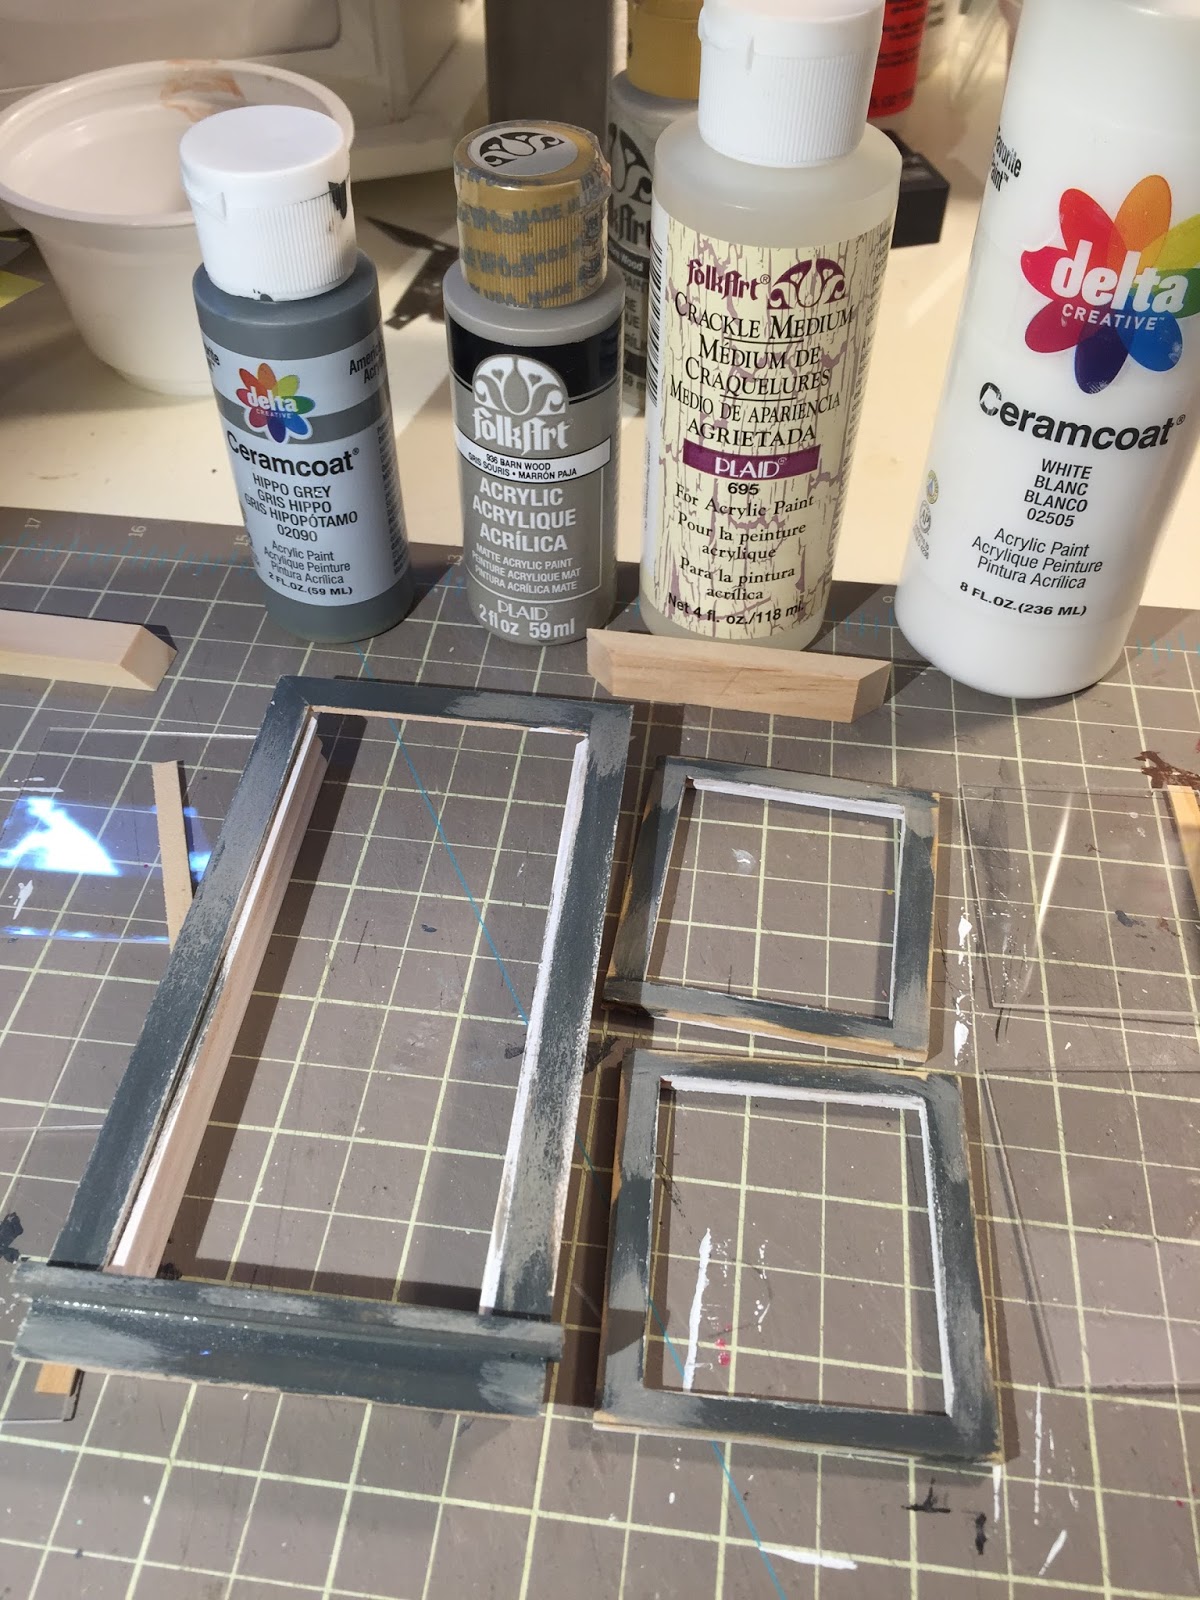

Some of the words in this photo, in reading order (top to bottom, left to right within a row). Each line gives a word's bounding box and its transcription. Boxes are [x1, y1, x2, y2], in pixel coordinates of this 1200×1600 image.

[1051, 239, 1188, 313] delta
[675, 291, 760, 339] CRACKLE
[769, 304, 854, 340] MEDIUM
[1062, 303, 1158, 331] CREATIVE
[698, 333, 786, 370] MÉDIUM
[794, 346, 821, 366] DE
[685, 356, 831, 397] CRAQUELURES
[247, 386, 298, 412] delta
[670, 374, 714, 415] MEDIO
[719, 401, 741, 423] DE
[747, 391, 841, 424] APARIENCIA
[256, 408, 292, 419] CREATIVE
[687, 418, 816, 448] AGRIETADA
[483, 460, 510, 477] SOURIS
[518, 470, 555, 480] MARRÓN
[558, 468, 577, 478] PAJA
[486, 453, 498, 465] 936
[500, 458, 522, 470] BARN
[524, 462, 551, 471] WOOD
[714, 456, 780, 478] PLAID
[1041, 458, 1093, 480] WHITE
[252, 472, 289, 496] HIPPO
[293, 485, 331, 499] GREY
[479, 477, 563, 507] ACRYLIC
[727, 482, 759, 496] 695
[1034, 475, 1089, 496] BLANC
[244, 492, 268, 515] GRIS
[269, 506, 358, 528] HIPOPÓTAMO
[257, 488, 285, 509] GRIS
[288, 499, 332, 514] HIPPO
[472, 495, 576, 530] ACRYLIQUE
[675, 482, 699, 507] For
[704, 498, 767, 520] Acrylic
[774, 495, 815, 515] Paint
[1024, 489, 1089, 513] BLANCO
[677, 510, 713, 537] Pour
[719, 526, 734, 542] la
[740, 523, 807, 545] peinture
[1026, 507, 1075, 527] 02505
[276, 523, 318, 542] 02090
[480, 522, 568, 553] ACRÍLICA
[994, 528, 1047, 554] Acrylic
[1050, 541, 1090, 558] Paint
[264, 546, 304, 570] Acrylique
[307, 562, 351, 573] Peinture
[272, 540, 304, 559] Acrylic
[307, 550, 334, 561] Paint
[476, 543, 501, 563] MATTE
[503, 556, 542, 571] ACRYLIC
[545, 557, 573, 570] PAINT
[701, 544, 776, 563] acrylique
[971, 536, 1039, 570] Acrylique
[1042, 557, 1103, 574] Peinture
[268, 571, 274, 580] 2
[271, 560, 302, 581] Pintura
[472, 550, 506, 577] PEINTURE
[507, 570, 561, 584] ACRYLIQUE
[562, 567, 581, 581] MAT
[475, 565, 506, 589] PINTURA
[508, 583, 550, 595] ACRÍLICA
[551, 580, 578, 594] MATE
[680, 556, 713, 580] Para
[718, 572, 733, 583] la
[738, 568, 796, 587] pintura
[977, 555, 1027, 584] Pintura
[1030, 572, 1087, 590] Acrílica
[706, 587, 764, 600] acrílica
[959, 581, 968, 592] 8
[497, 600, 549, 621] PLAID
[668, 591, 690, 615] Net
[692, 607, 702, 618] 4
[500, 619, 520, 636] oz
[529, 621, 551, 639] 59
